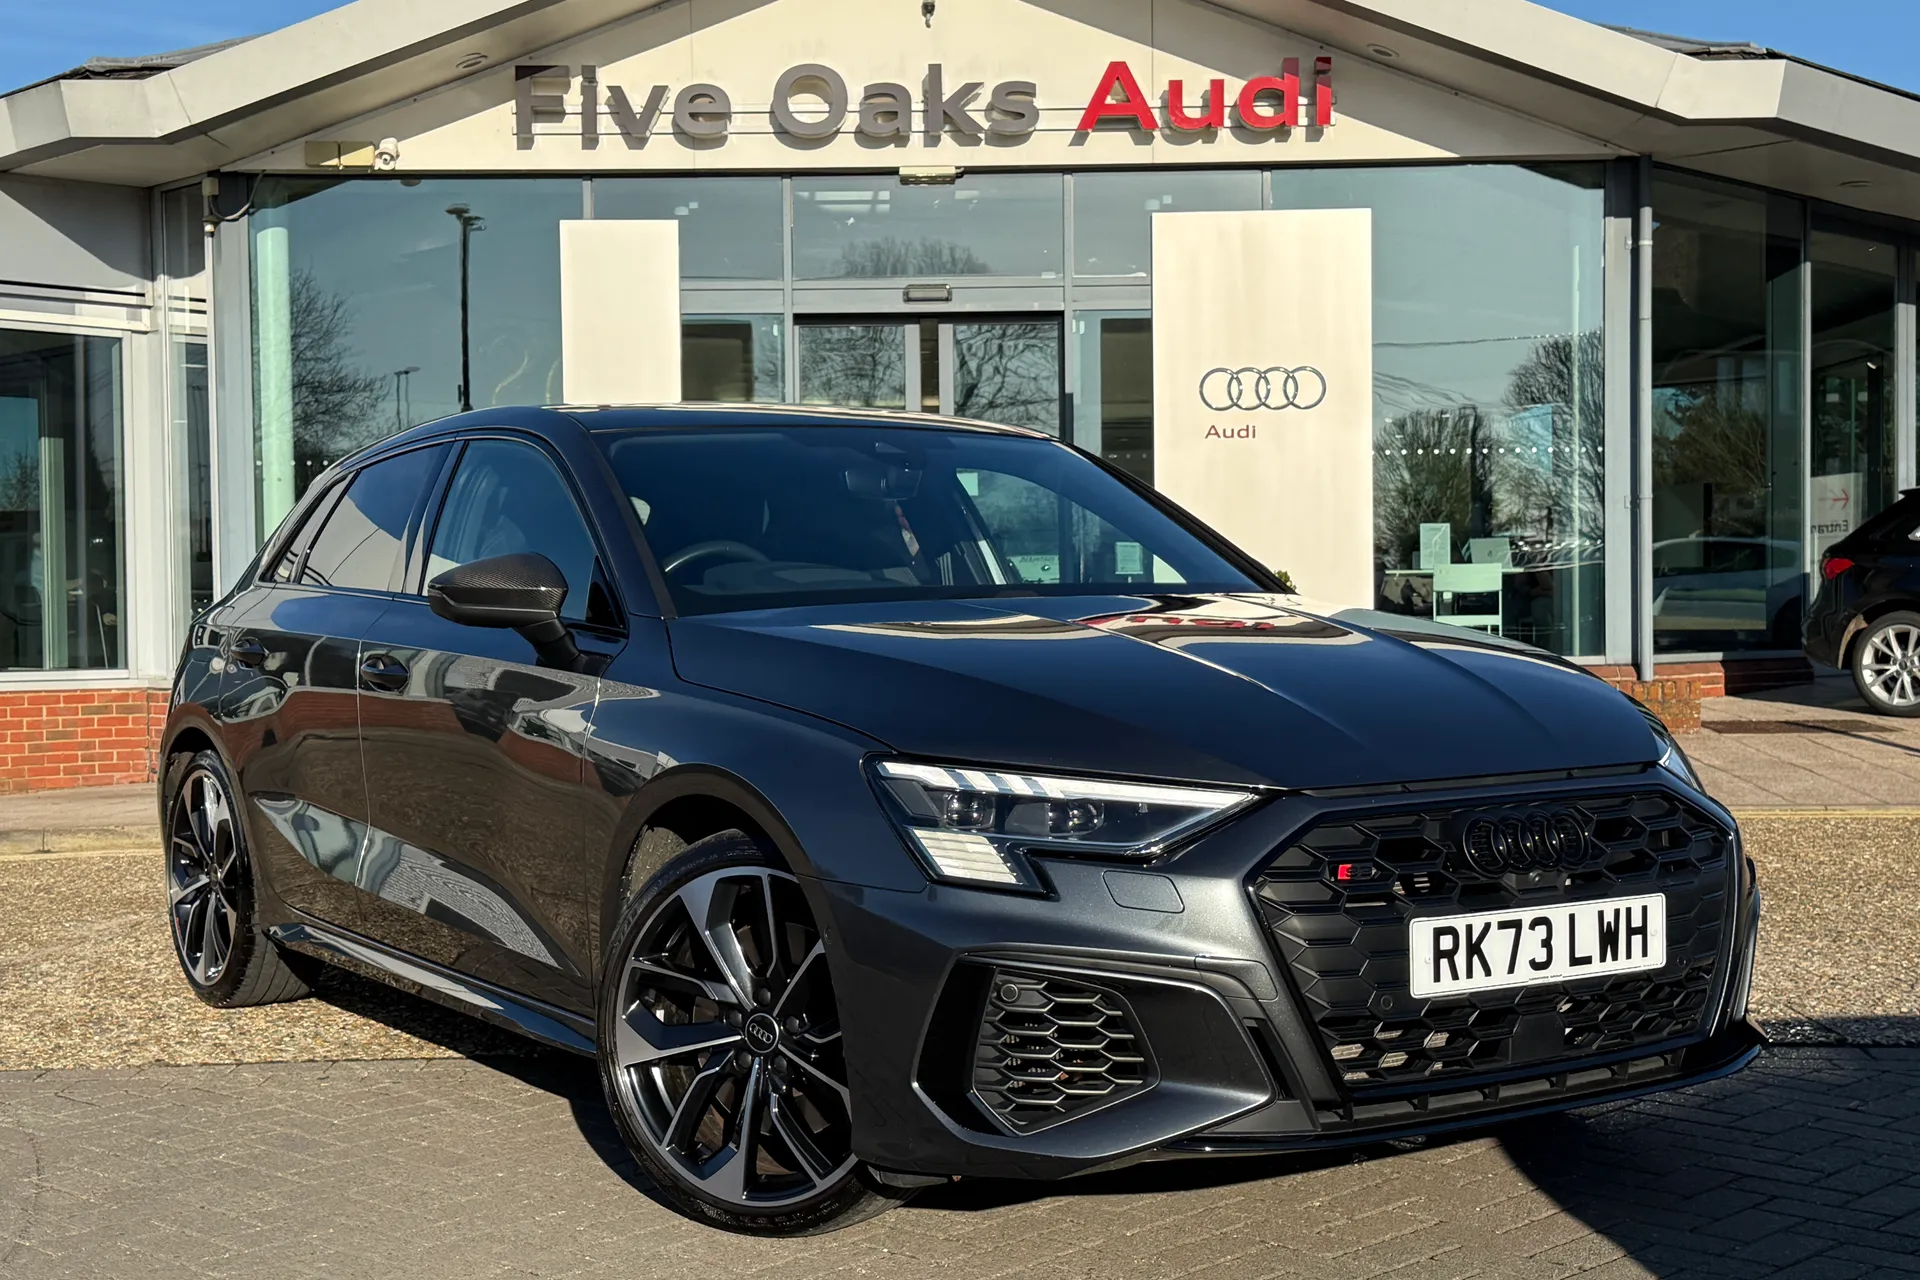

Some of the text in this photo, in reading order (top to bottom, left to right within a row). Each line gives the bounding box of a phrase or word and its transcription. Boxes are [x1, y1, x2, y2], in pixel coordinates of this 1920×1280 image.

[515, 56, 1332, 138] Five Oaks Audi
[1204, 424, 1256, 439] Audi
[1432, 904, 1648, 983] RK73 LWH
